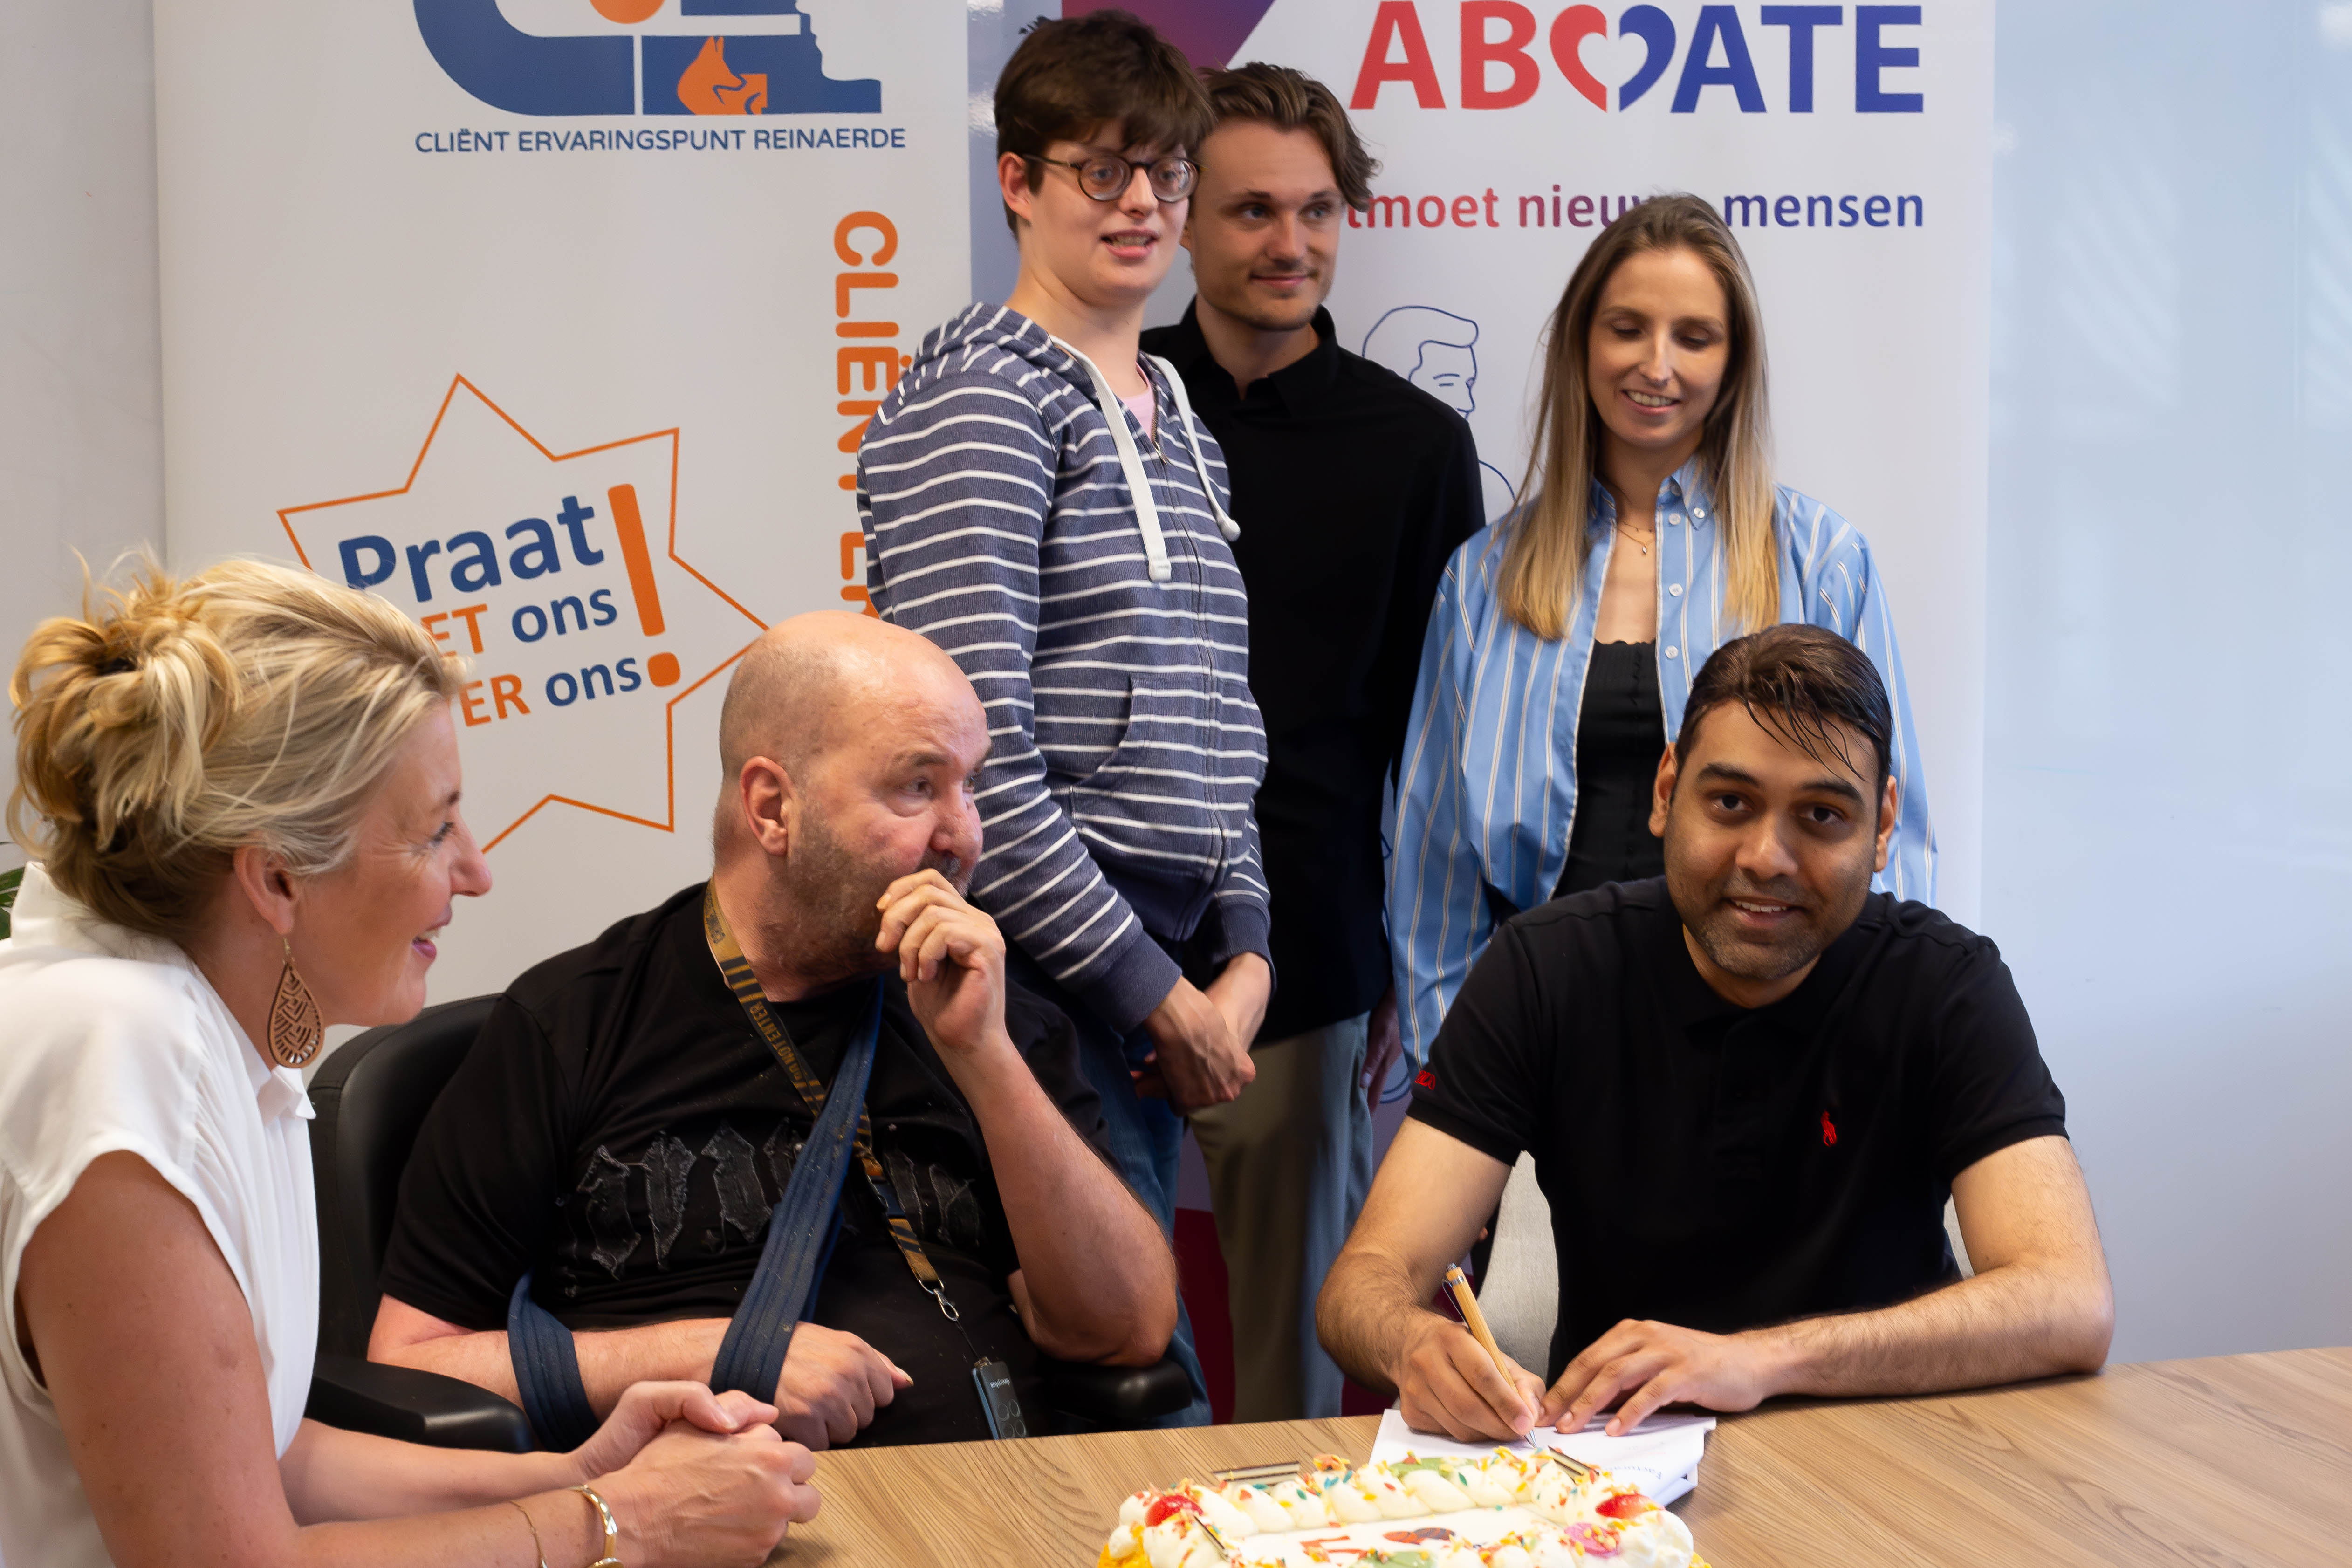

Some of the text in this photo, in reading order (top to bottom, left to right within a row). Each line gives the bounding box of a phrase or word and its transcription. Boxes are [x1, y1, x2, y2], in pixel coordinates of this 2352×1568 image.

[415, 127, 905, 153] CLIËNT ERVARINGSPUNT REINAERDE
[1347, 184, 1924, 228] tmoet nieu mensen
[833, 211, 913, 491] CLIËN
[420, 589, 617, 658] ET ons
[459, 657, 642, 727] ER ons
[749, 1001, 782, 1042] ENTER
